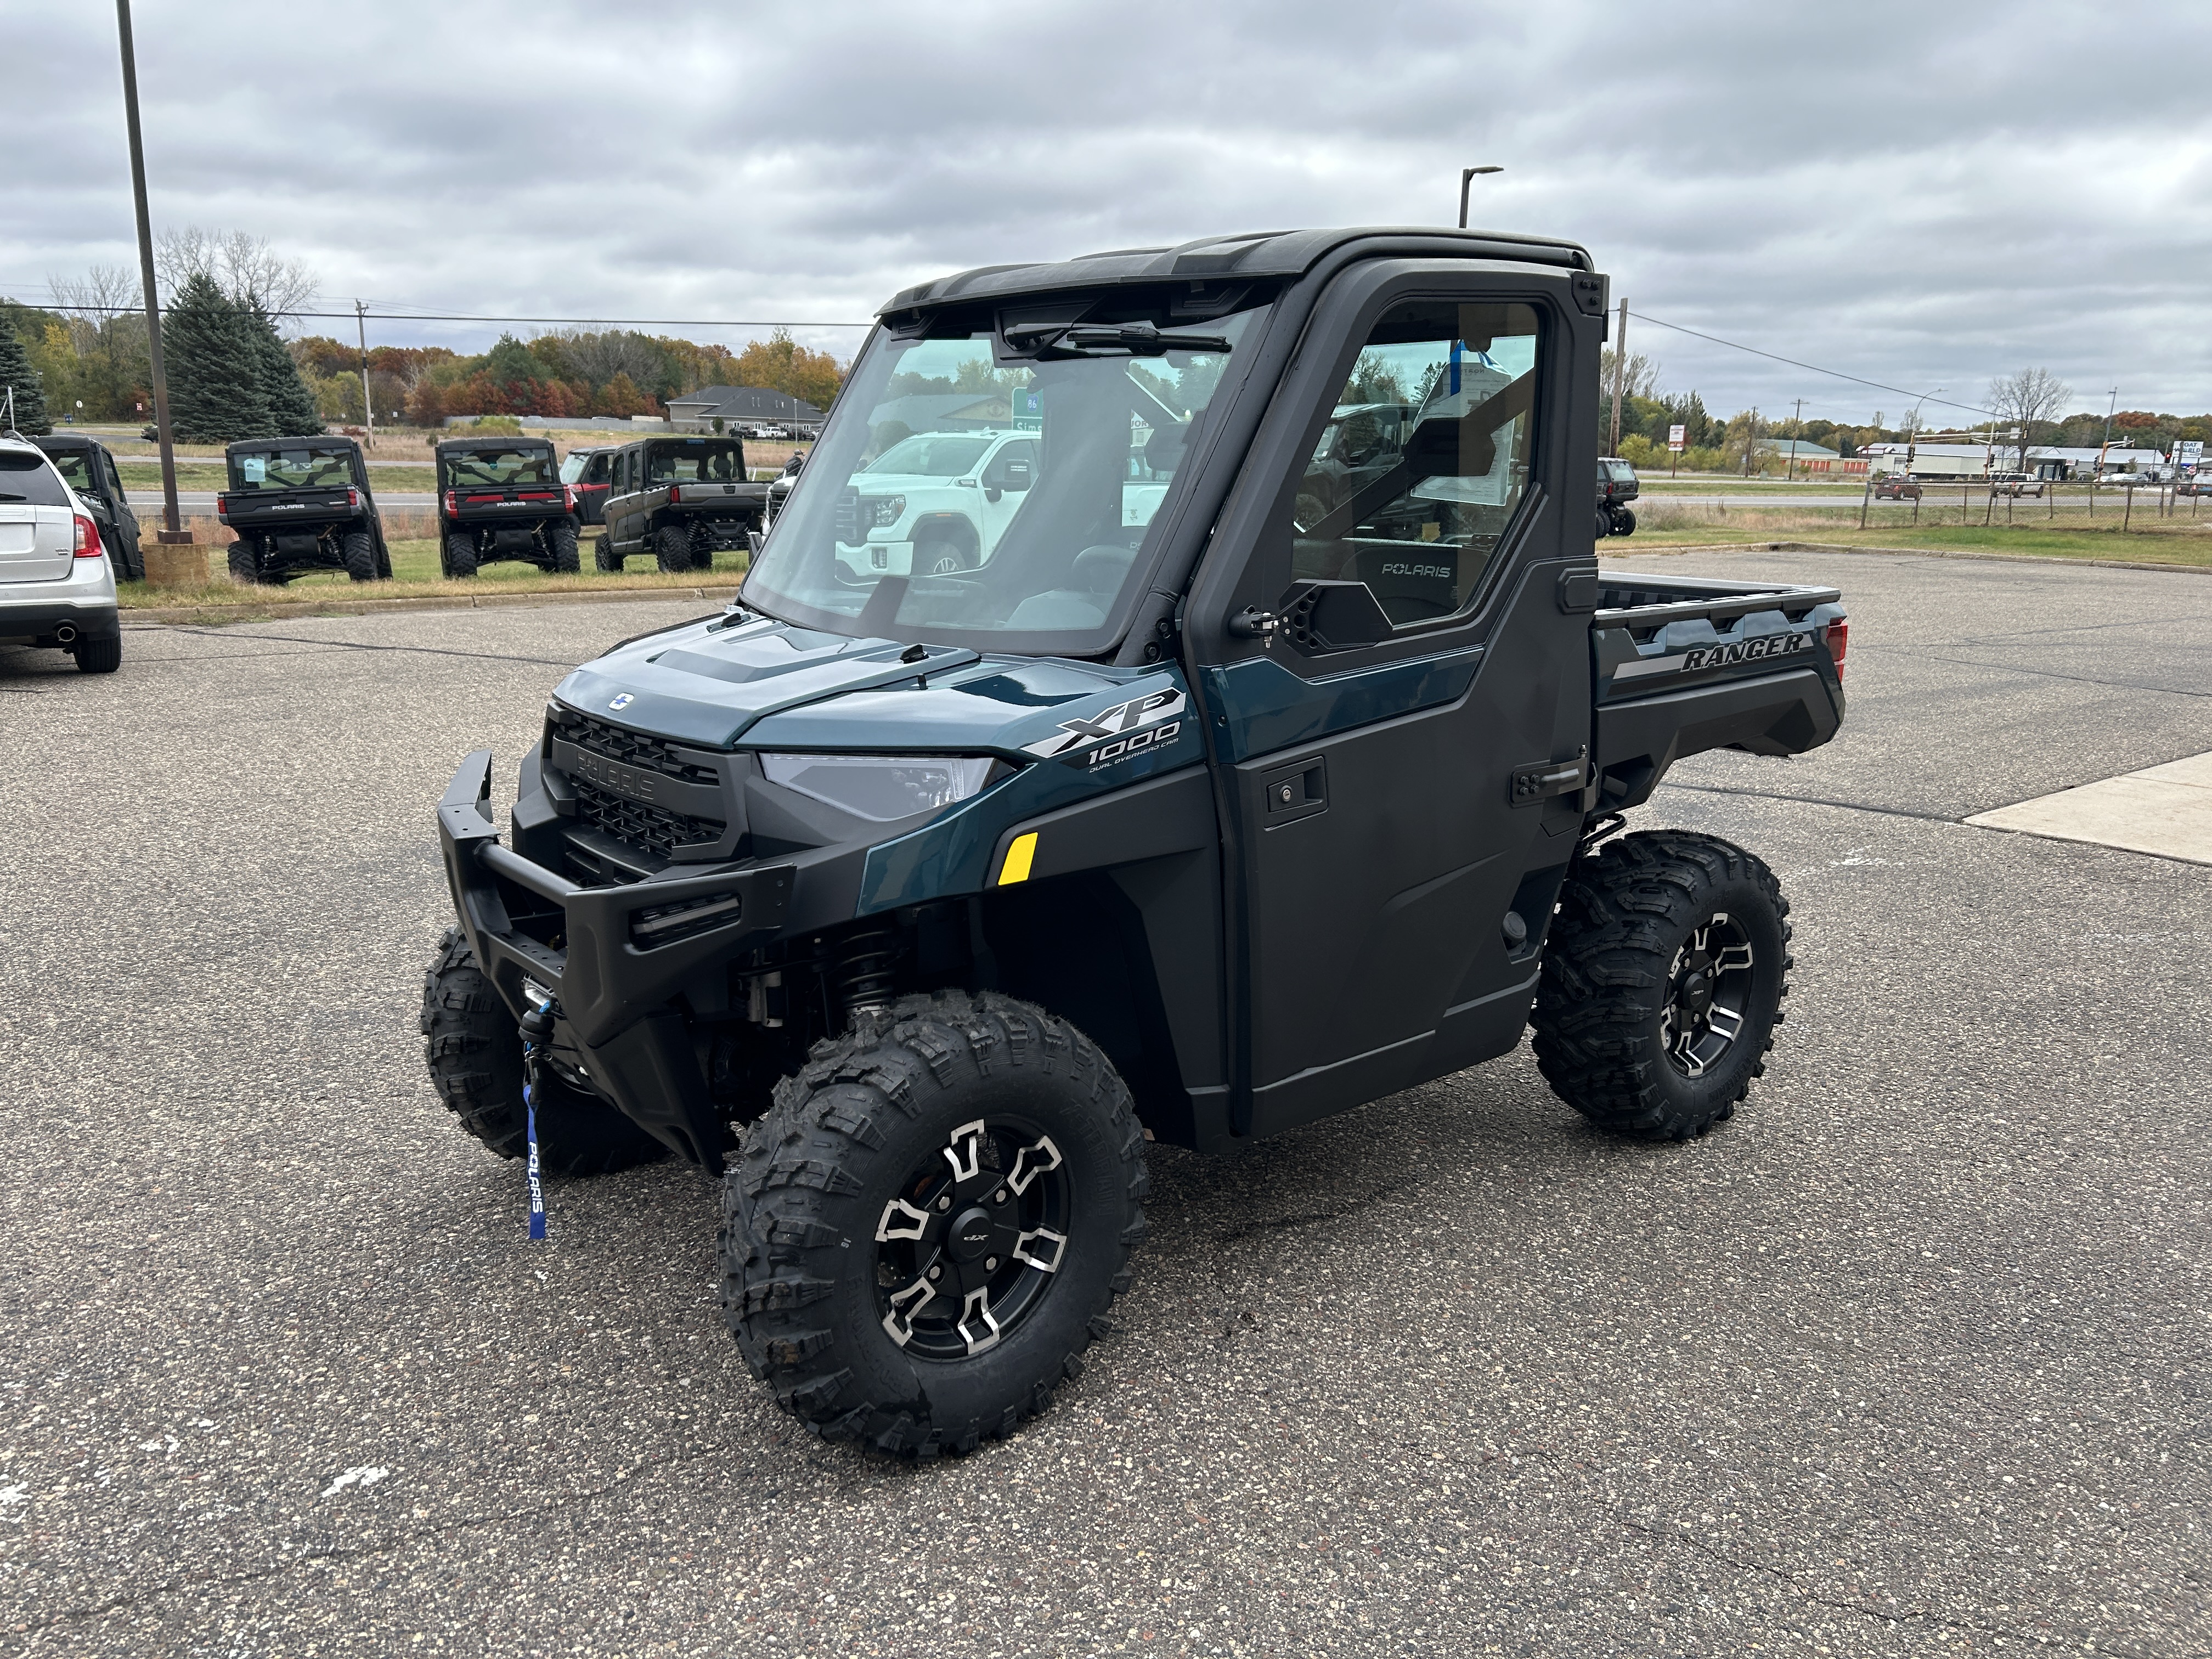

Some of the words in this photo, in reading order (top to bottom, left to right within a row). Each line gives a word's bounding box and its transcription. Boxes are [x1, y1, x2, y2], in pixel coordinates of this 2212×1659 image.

[1028, 399, 1037, 409] 86
[1381, 563, 1451, 578] POLARIS
[1680, 633, 1804, 672] RANGER
[1049, 687, 1182, 756] XP
[1089, 721, 1180, 765] 1000
[1089, 762, 1112, 773] DUAL
[1114, 745, 1160, 765] OVERHEAD
[1160, 738, 1179, 748] CAM
[577, 751, 655, 800] POLARIS
[529, 1141, 543, 1213] POLARIS
